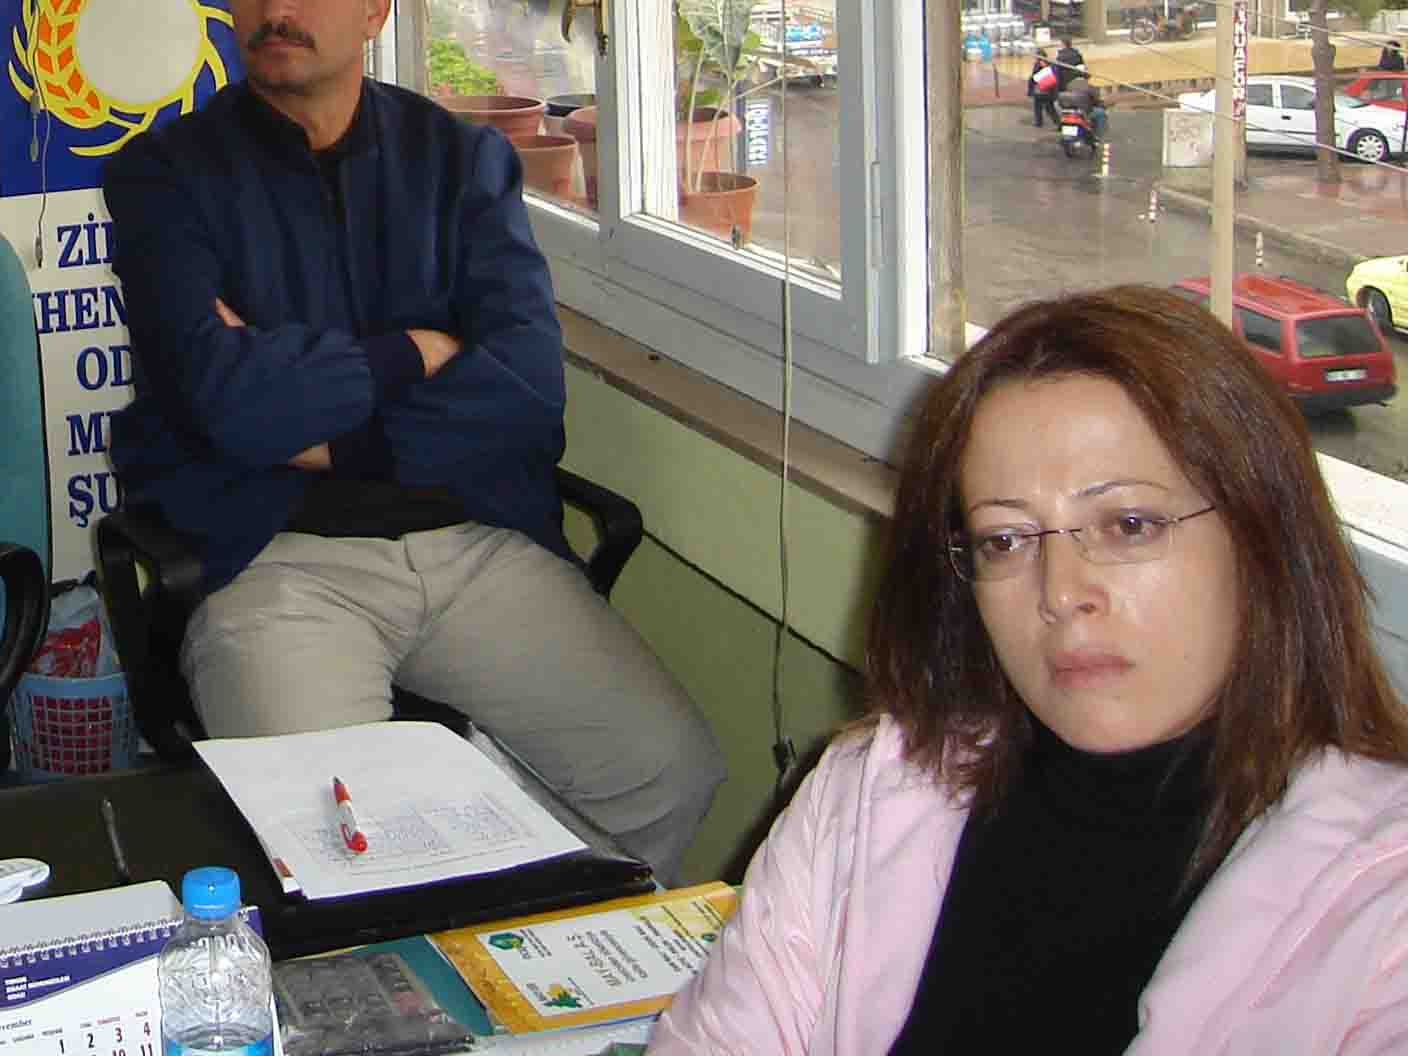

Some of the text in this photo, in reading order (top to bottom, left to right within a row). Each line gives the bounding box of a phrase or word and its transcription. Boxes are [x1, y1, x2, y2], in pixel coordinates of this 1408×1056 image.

[32, 285, 128, 334] HEN
[87, 1032, 95, 1049] 2
[114, 1027, 123, 1043] 3
[143, 1021, 151, 1037] 4
